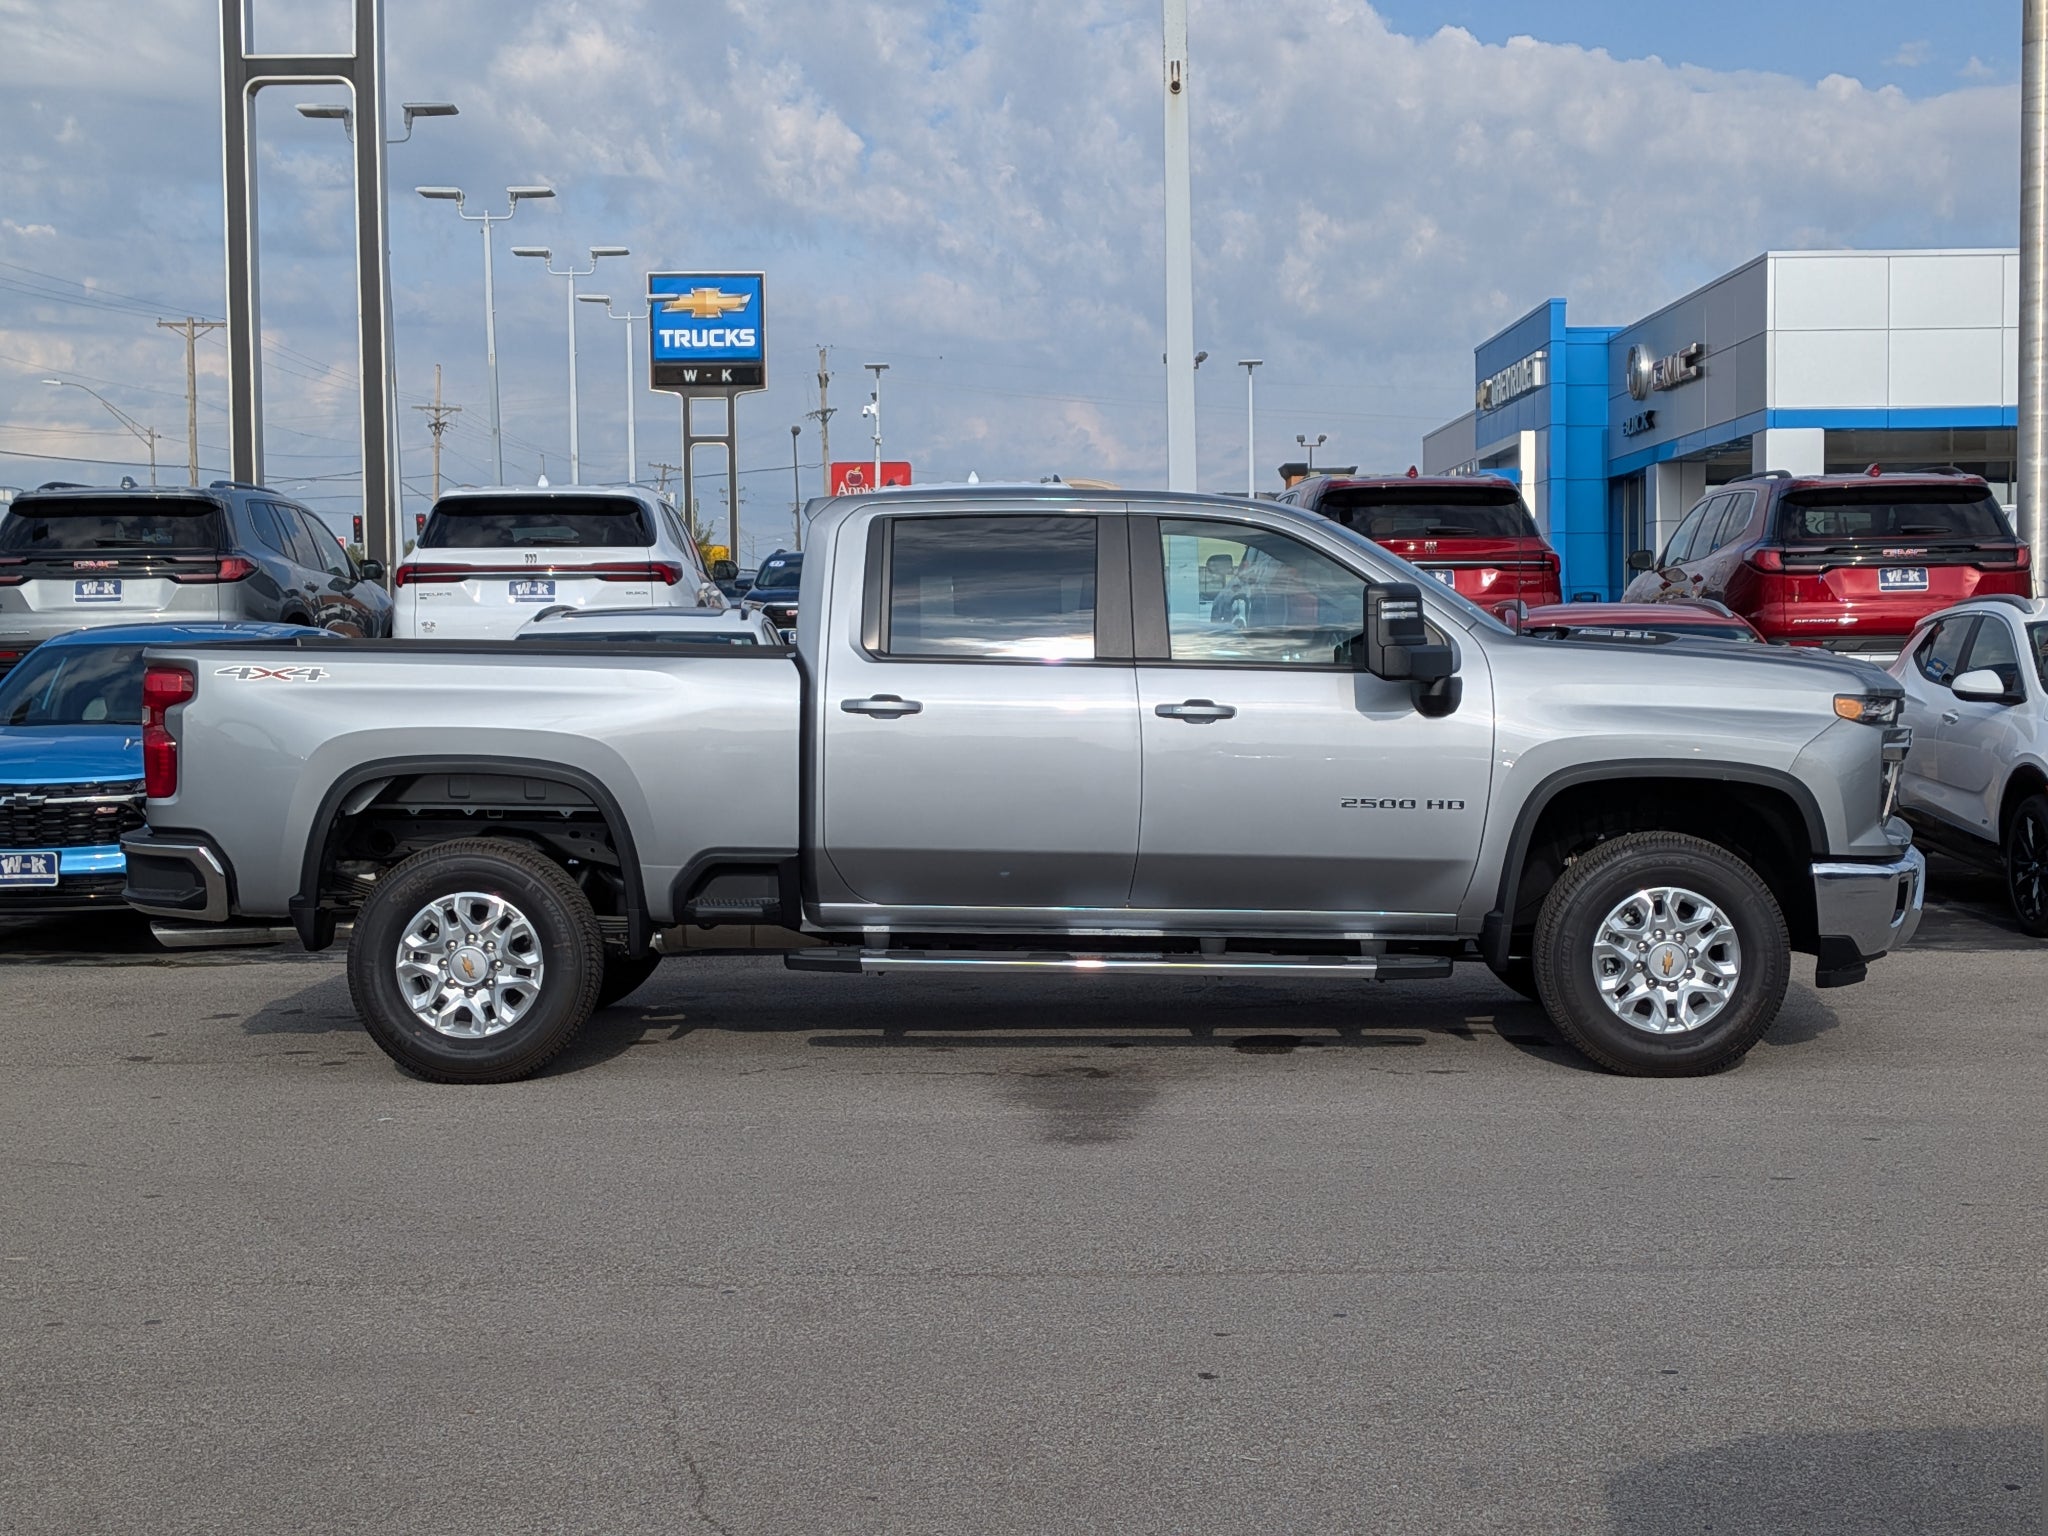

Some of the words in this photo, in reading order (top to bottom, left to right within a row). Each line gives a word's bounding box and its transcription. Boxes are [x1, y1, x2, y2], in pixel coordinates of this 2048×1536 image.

[659, 328, 756, 348] TRUCKS
[1651, 342, 1697, 392] GMC
[1491, 350, 1547, 407] CHEVROLET
[1622, 409, 1656, 436] BUICK
[1882, 548, 1928, 558] GMC
[73, 560, 119, 570] GMC
[1886, 569, 1920, 583] W-K
[81, 581, 116, 595] W-K
[515, 581, 550, 595] W-K
[1340, 797, 1416, 809] 2500
[1426, 799, 1465, 810] HD
[1, 855, 48, 874] W-K
